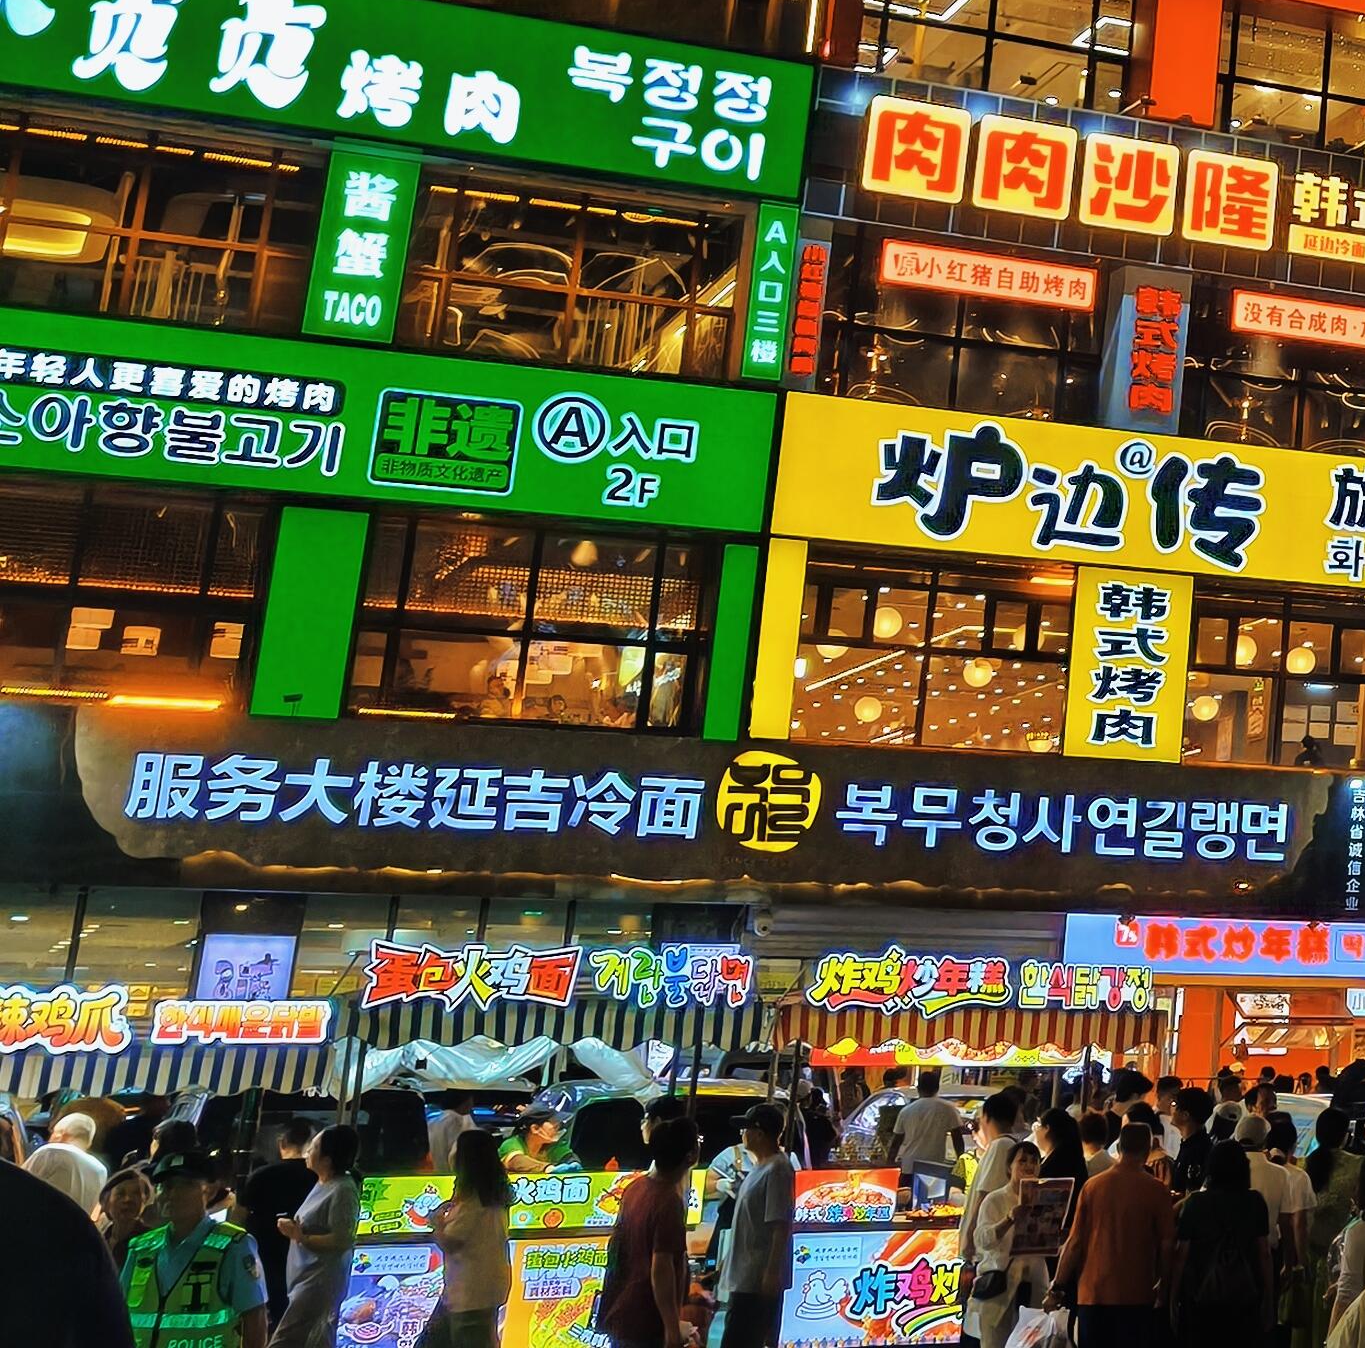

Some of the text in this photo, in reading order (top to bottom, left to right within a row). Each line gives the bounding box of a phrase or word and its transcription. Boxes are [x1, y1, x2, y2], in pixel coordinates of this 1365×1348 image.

[567, 45, 772, 124] 복정정
[632, 115, 766, 182] 구이
[872, 111, 1271, 242] 肉肉沙隆
[323, 289, 382, 328] TACO
[384, 396, 515, 462] 非遗
[611, 417, 699, 462] 入口
[603, 465, 661, 506] 2F
[1090, 580, 1172, 747] 韩式烤肉
[125, 753, 704, 840] 服务大楼延吉冷面
